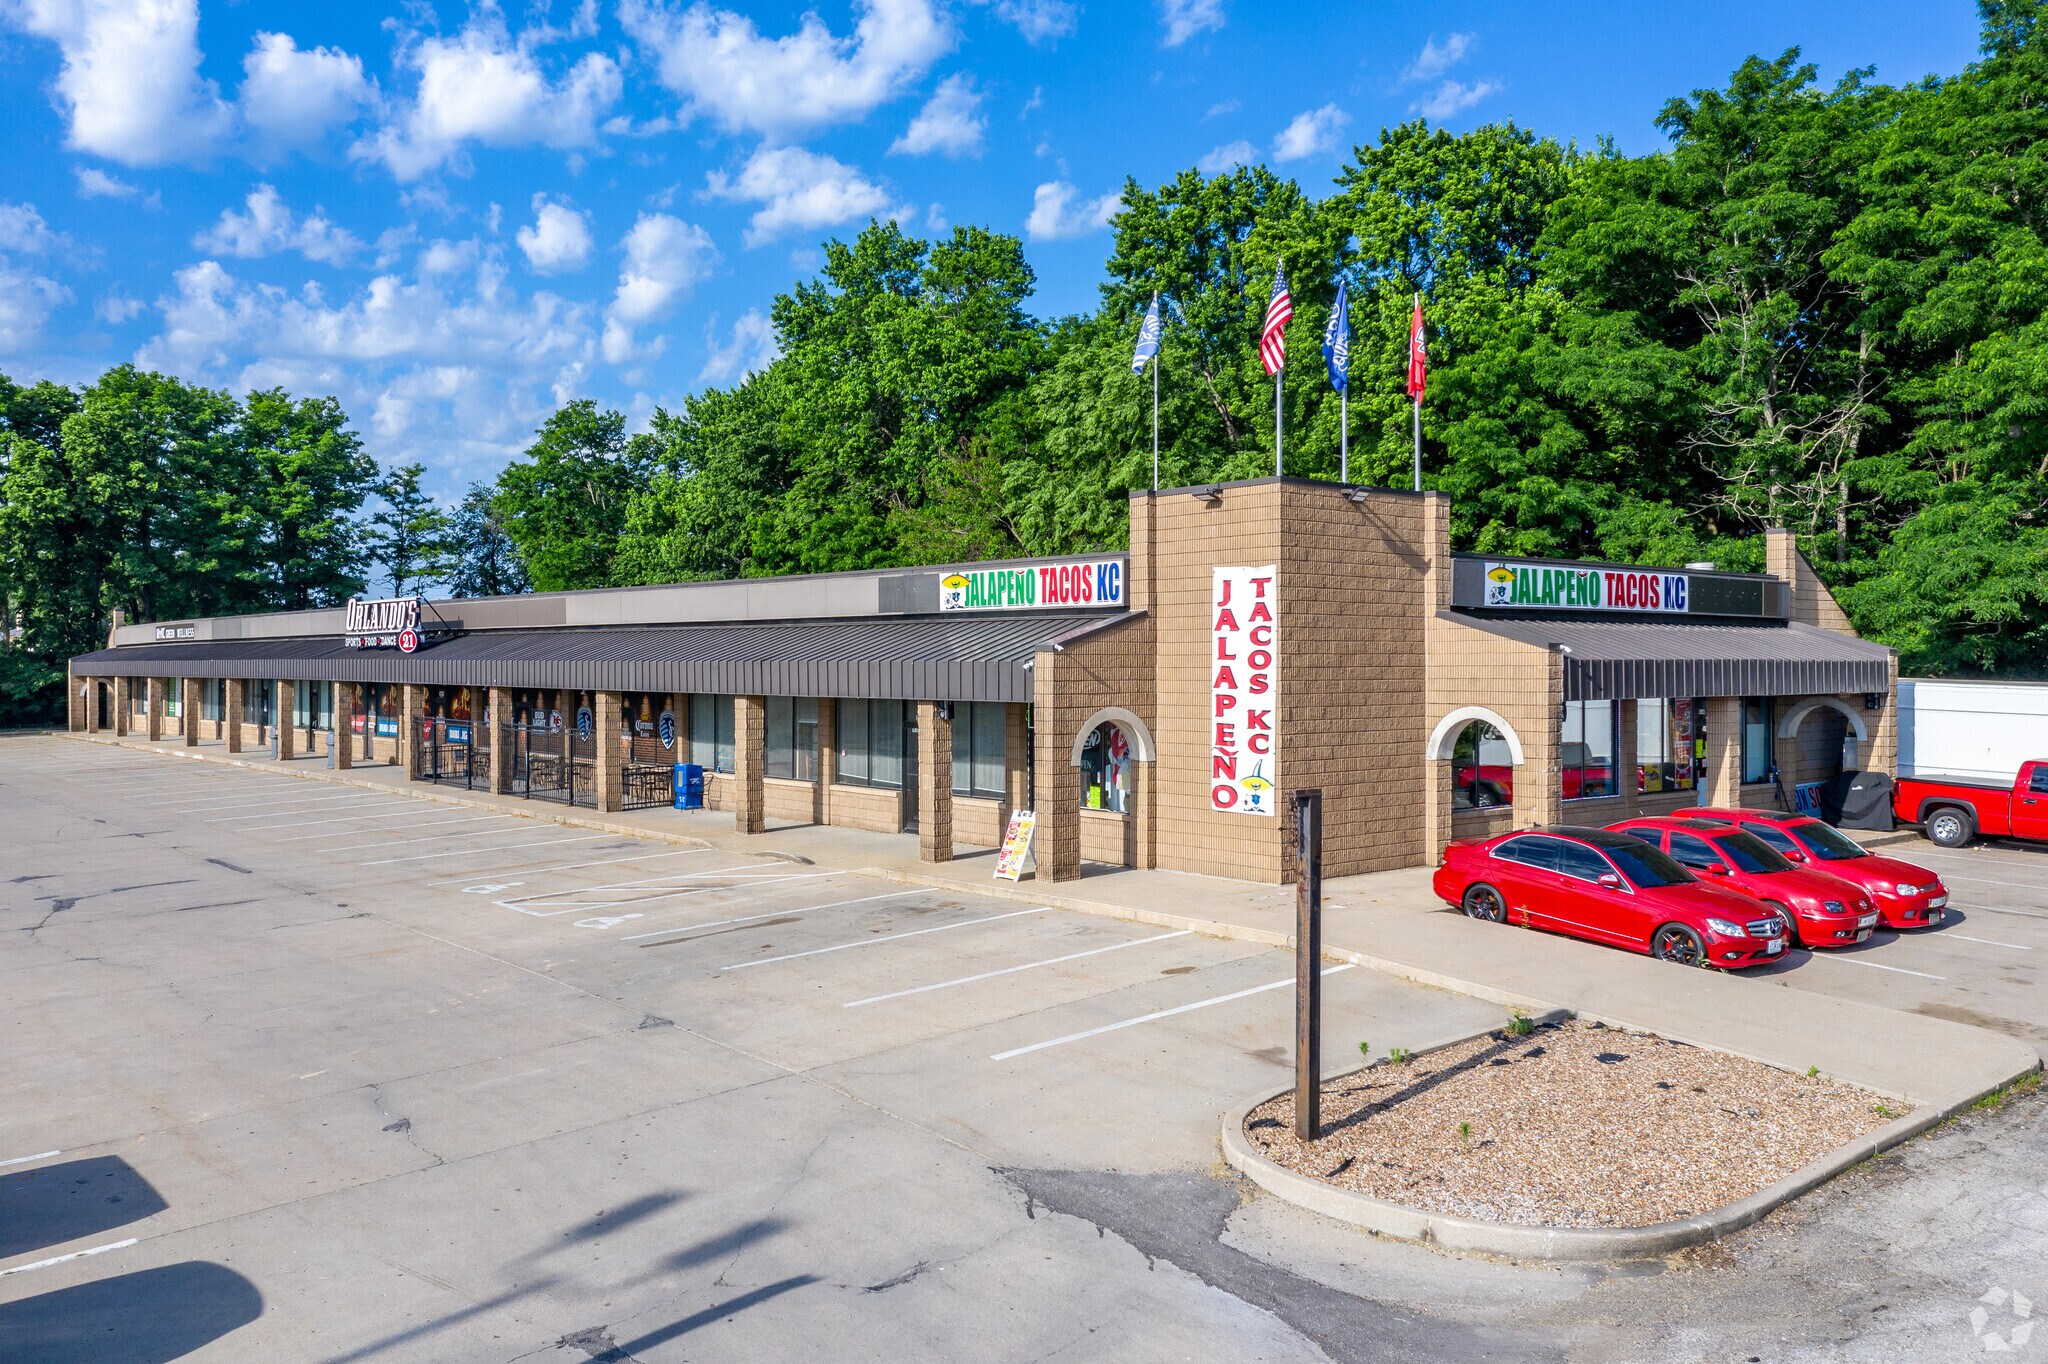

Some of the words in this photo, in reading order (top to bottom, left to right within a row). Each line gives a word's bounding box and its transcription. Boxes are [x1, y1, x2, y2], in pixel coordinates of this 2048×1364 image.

[964, 568, 1035, 607] JALAPEÑO
[1039, 564, 1093, 604] TACOS
[1097, 562, 1120, 602] KC
[1510, 567, 1600, 607] JALAPEÑO
[1605, 572, 1660, 609] TACOS
[1664, 575, 1686, 610] KC
[346, 598, 417, 631] ORLANDO'S
[1247, 577, 1273, 694] TACOS
[345, 636, 361, 647] SPORTS
[364, 636, 377, 647] FOOD
[402, 633, 414, 648] 21
[1212, 579, 1240, 809] JALAPEÑO
[1247, 709, 1272, 754] KC
